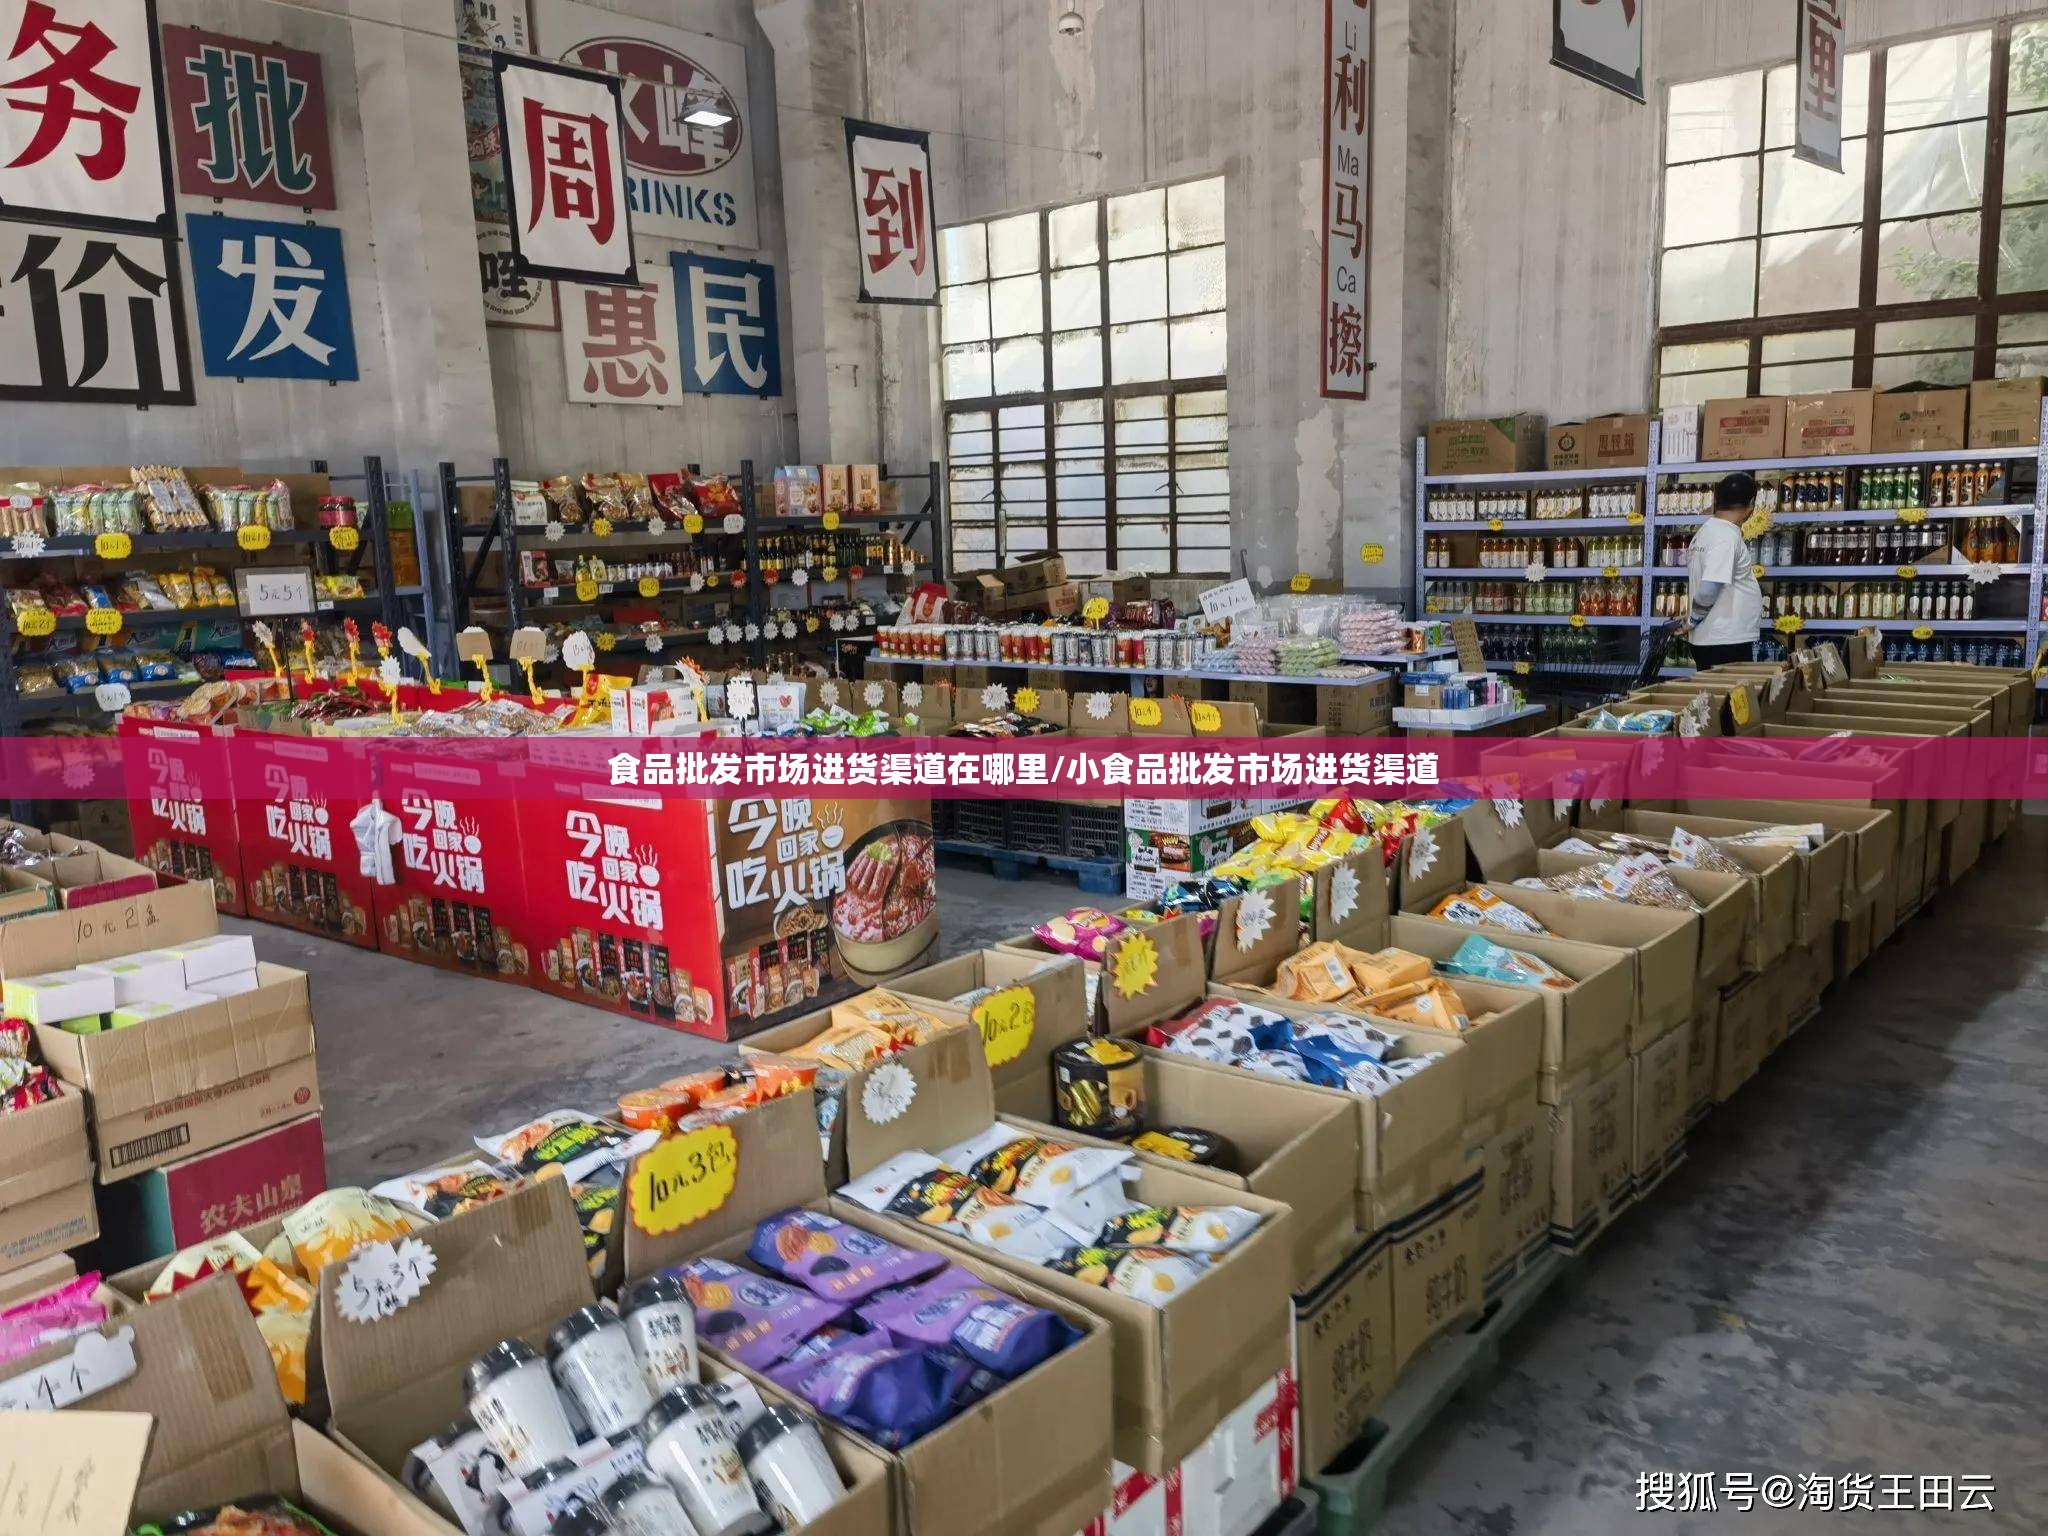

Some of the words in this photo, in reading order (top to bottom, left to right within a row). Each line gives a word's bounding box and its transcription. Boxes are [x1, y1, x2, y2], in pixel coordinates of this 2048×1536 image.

[1345, 20, 1357, 52] Li
[0, 0, 142, 181] 务
[185, 44, 317, 195] 批
[1333, 52, 1367, 136] 利
[523, 96, 615, 246] 周
[1337, 146, 1360, 177] Ma
[862, 167, 926, 277] 到
[1331, 181, 1363, 259] 马
[217, 235, 337, 367] 发
[1336, 265, 1357, 294] Ca
[0, 233, 169, 389] 价
[582, 283, 670, 398] 惠
[689, 266, 769, 390] 民
[1329, 301, 1363, 377] 擦
[150, 785, 207, 837] 吃火锅
[265, 763, 310, 804] 今晚
[289, 801, 315, 823] 回家
[401, 787, 458, 831] 今晚
[265, 804, 332, 861] 吃火锅
[432, 828, 464, 853] 回家
[565, 809, 632, 860] 今晚
[727, 792, 814, 851] 今晚
[776, 830, 820, 864] 回家
[402, 832, 485, 894] 吃火锅
[601, 856, 640, 885] 回家
[725, 850, 847, 915] 吃火锅
[565, 859, 664, 931] 吃火锅
[200, 1173, 303, 1234] 农夫山泉
